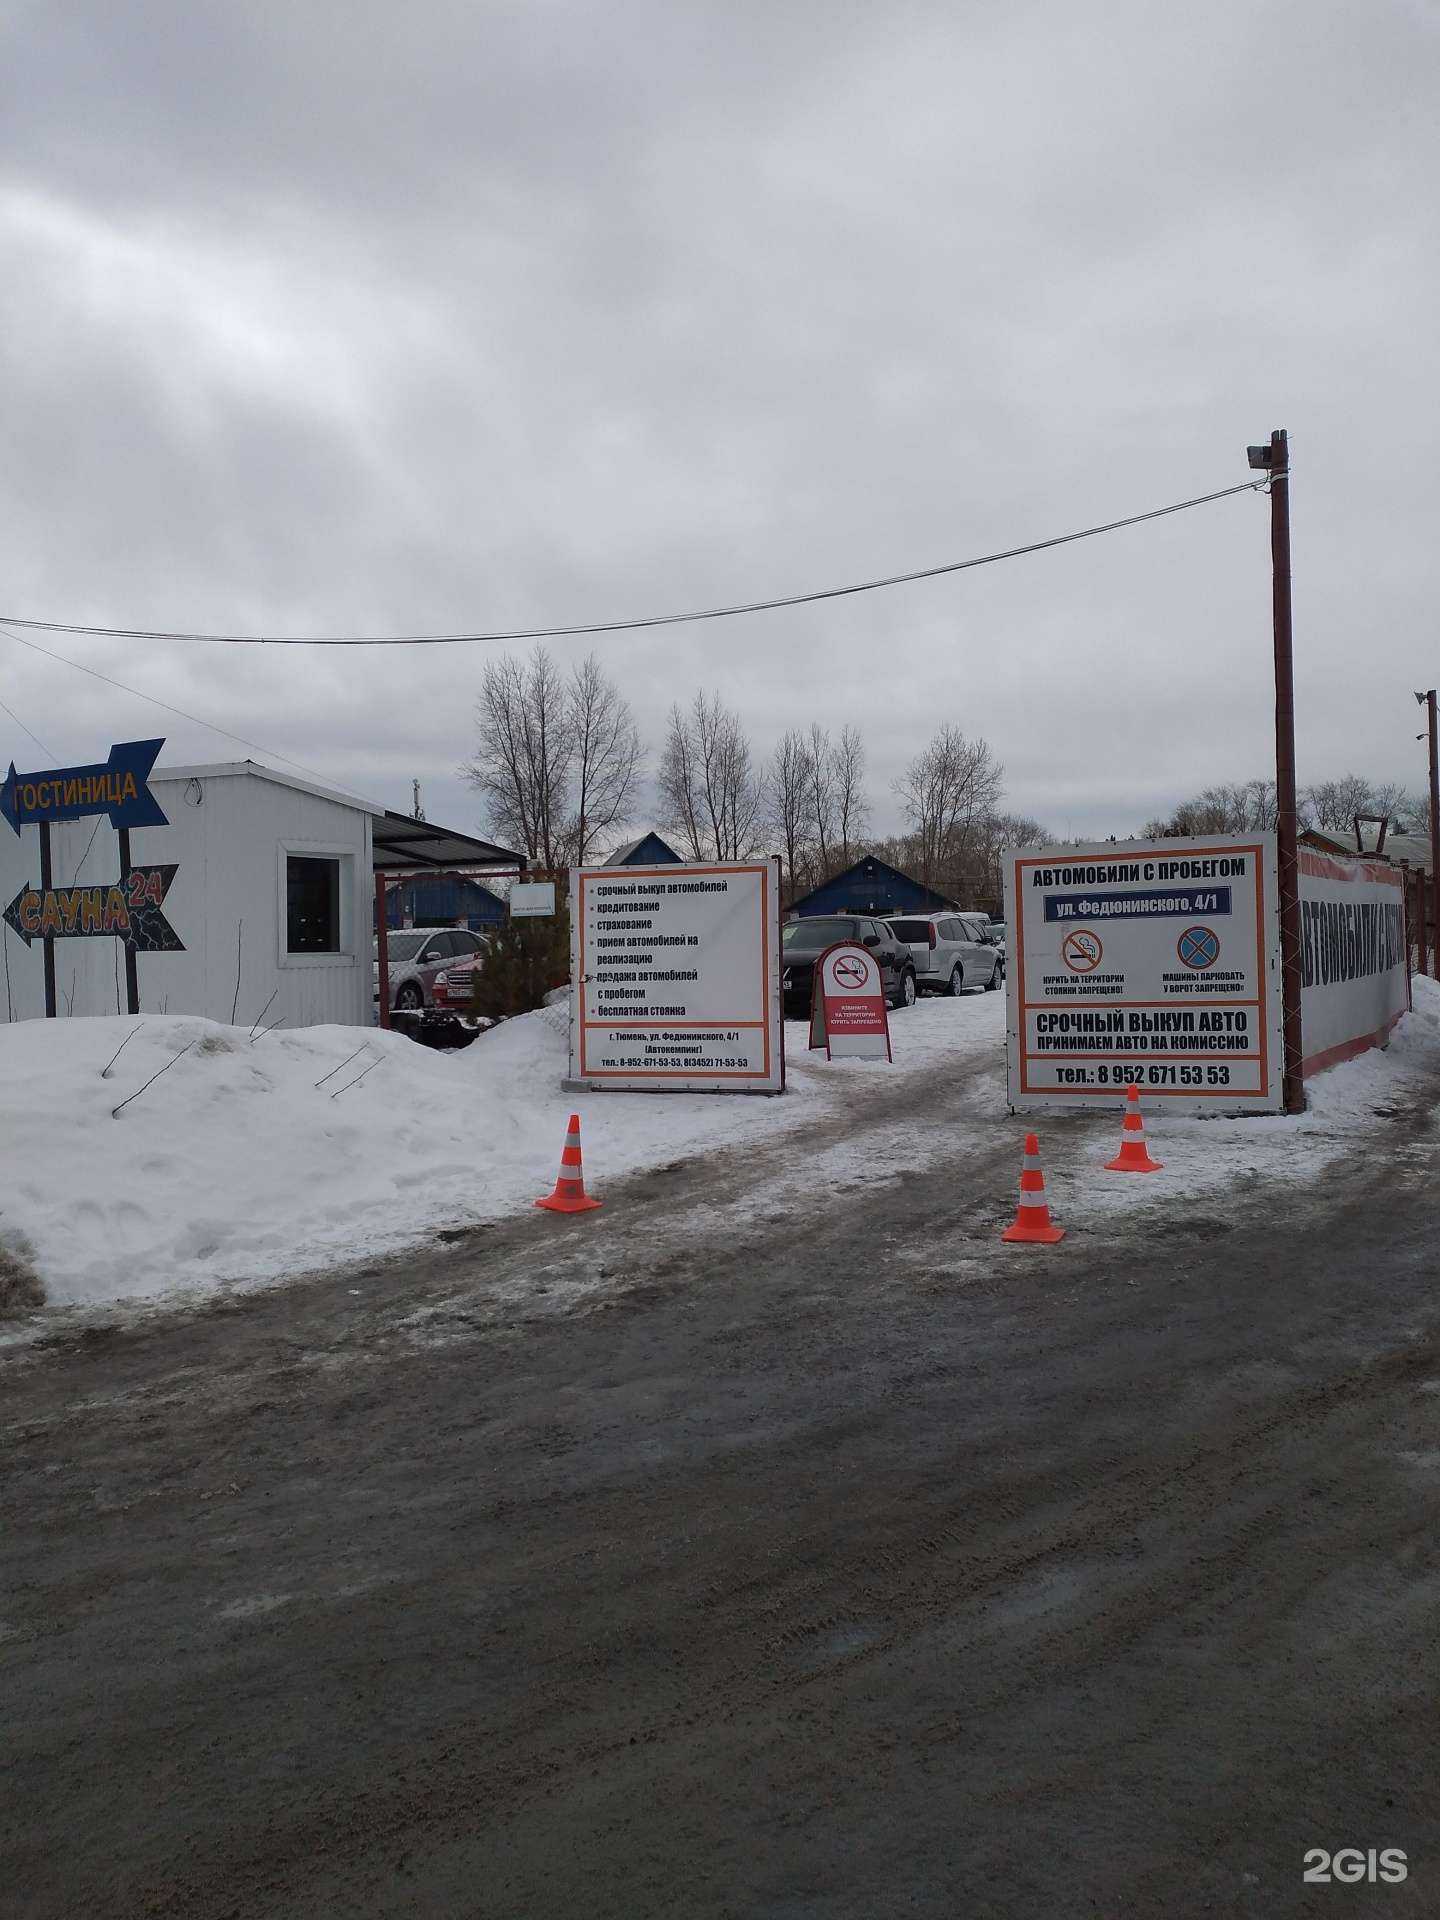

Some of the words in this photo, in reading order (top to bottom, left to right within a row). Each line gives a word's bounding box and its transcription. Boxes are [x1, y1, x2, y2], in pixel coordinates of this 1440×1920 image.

[14, 772, 138, 810] ГОСТИНИЦА
[1033, 863, 1139, 887] АВТОМОБИЛИ
[1143, 862, 1154, 881] С
[1158, 858, 1246, 879] ПРОБЕГОМ
[597, 883, 636, 897] срочный
[638, 884, 666, 895] выкуп
[667, 880, 728, 894] автомобилей
[19, 887, 130, 933] САУНА
[128, 872, 162, 906] 24
[597, 902, 660, 914] кредитование
[1056, 902, 1076, 917] ул.
[1078, 898, 1193, 917] Федюнинского,
[1194, 894, 1217, 910] 4/1
[597, 919, 652, 931] страхование
[597, 936, 625, 948] прием
[626, 934, 686, 947] автомобилей
[687, 936, 698, 946] на
[597, 954, 653, 966] реализацию
[597, 972, 636, 984] продажа
[638, 969, 698, 982] автомобилей
[1070, 975, 1080, 984] НА
[1081, 974, 1125, 984] ТЕРРИТОРИИ
[1162, 973, 1199, 982] МАШИНЫ
[1201, 972, 1245, 981] ПАРКОВАТЬ
[598, 990, 603, 999] с
[604, 988, 646, 1000] пробегом
[1078, 985, 1123, 995] ЗАПРЕЩЕНО!
[1163, 984, 1169, 993] У
[1170, 984, 1194, 993] ВОРОТ
[598, 1005, 648, 1017] бесплатная
[650, 1006, 686, 1016] стоянка
[1036, 1010, 1124, 1032] СРОЧНЫЙ
[1129, 1012, 1194, 1032] ВЫКУП
[1199, 1012, 1247, 1031] АВТО
[616, 1032, 648, 1042] Тюмень,
[650, 1033, 661, 1042] ул.
[727, 1032, 739, 1041] 4/1
[1037, 1036, 1113, 1050] ПРИНИМАЕМ
[1116, 1036, 1148, 1049] АВТО
[1151, 1036, 1168, 1049] НА
[1171, 1035, 1249, 1049] КОМИССИЮ
[645, 1045, 702, 1055] (Автокемпинг)
[715, 1058, 748, 1067] 71-53-53
[1056, 1067, 1095, 1084] тел.:
[1098, 1066, 1109, 1083] 8
[1113, 1066, 1145, 1084] 952
[1149, 1066, 1176, 1084] 671
[1180, 1066, 1202, 1084] 53
[1207, 1066, 1230, 1084] 53
